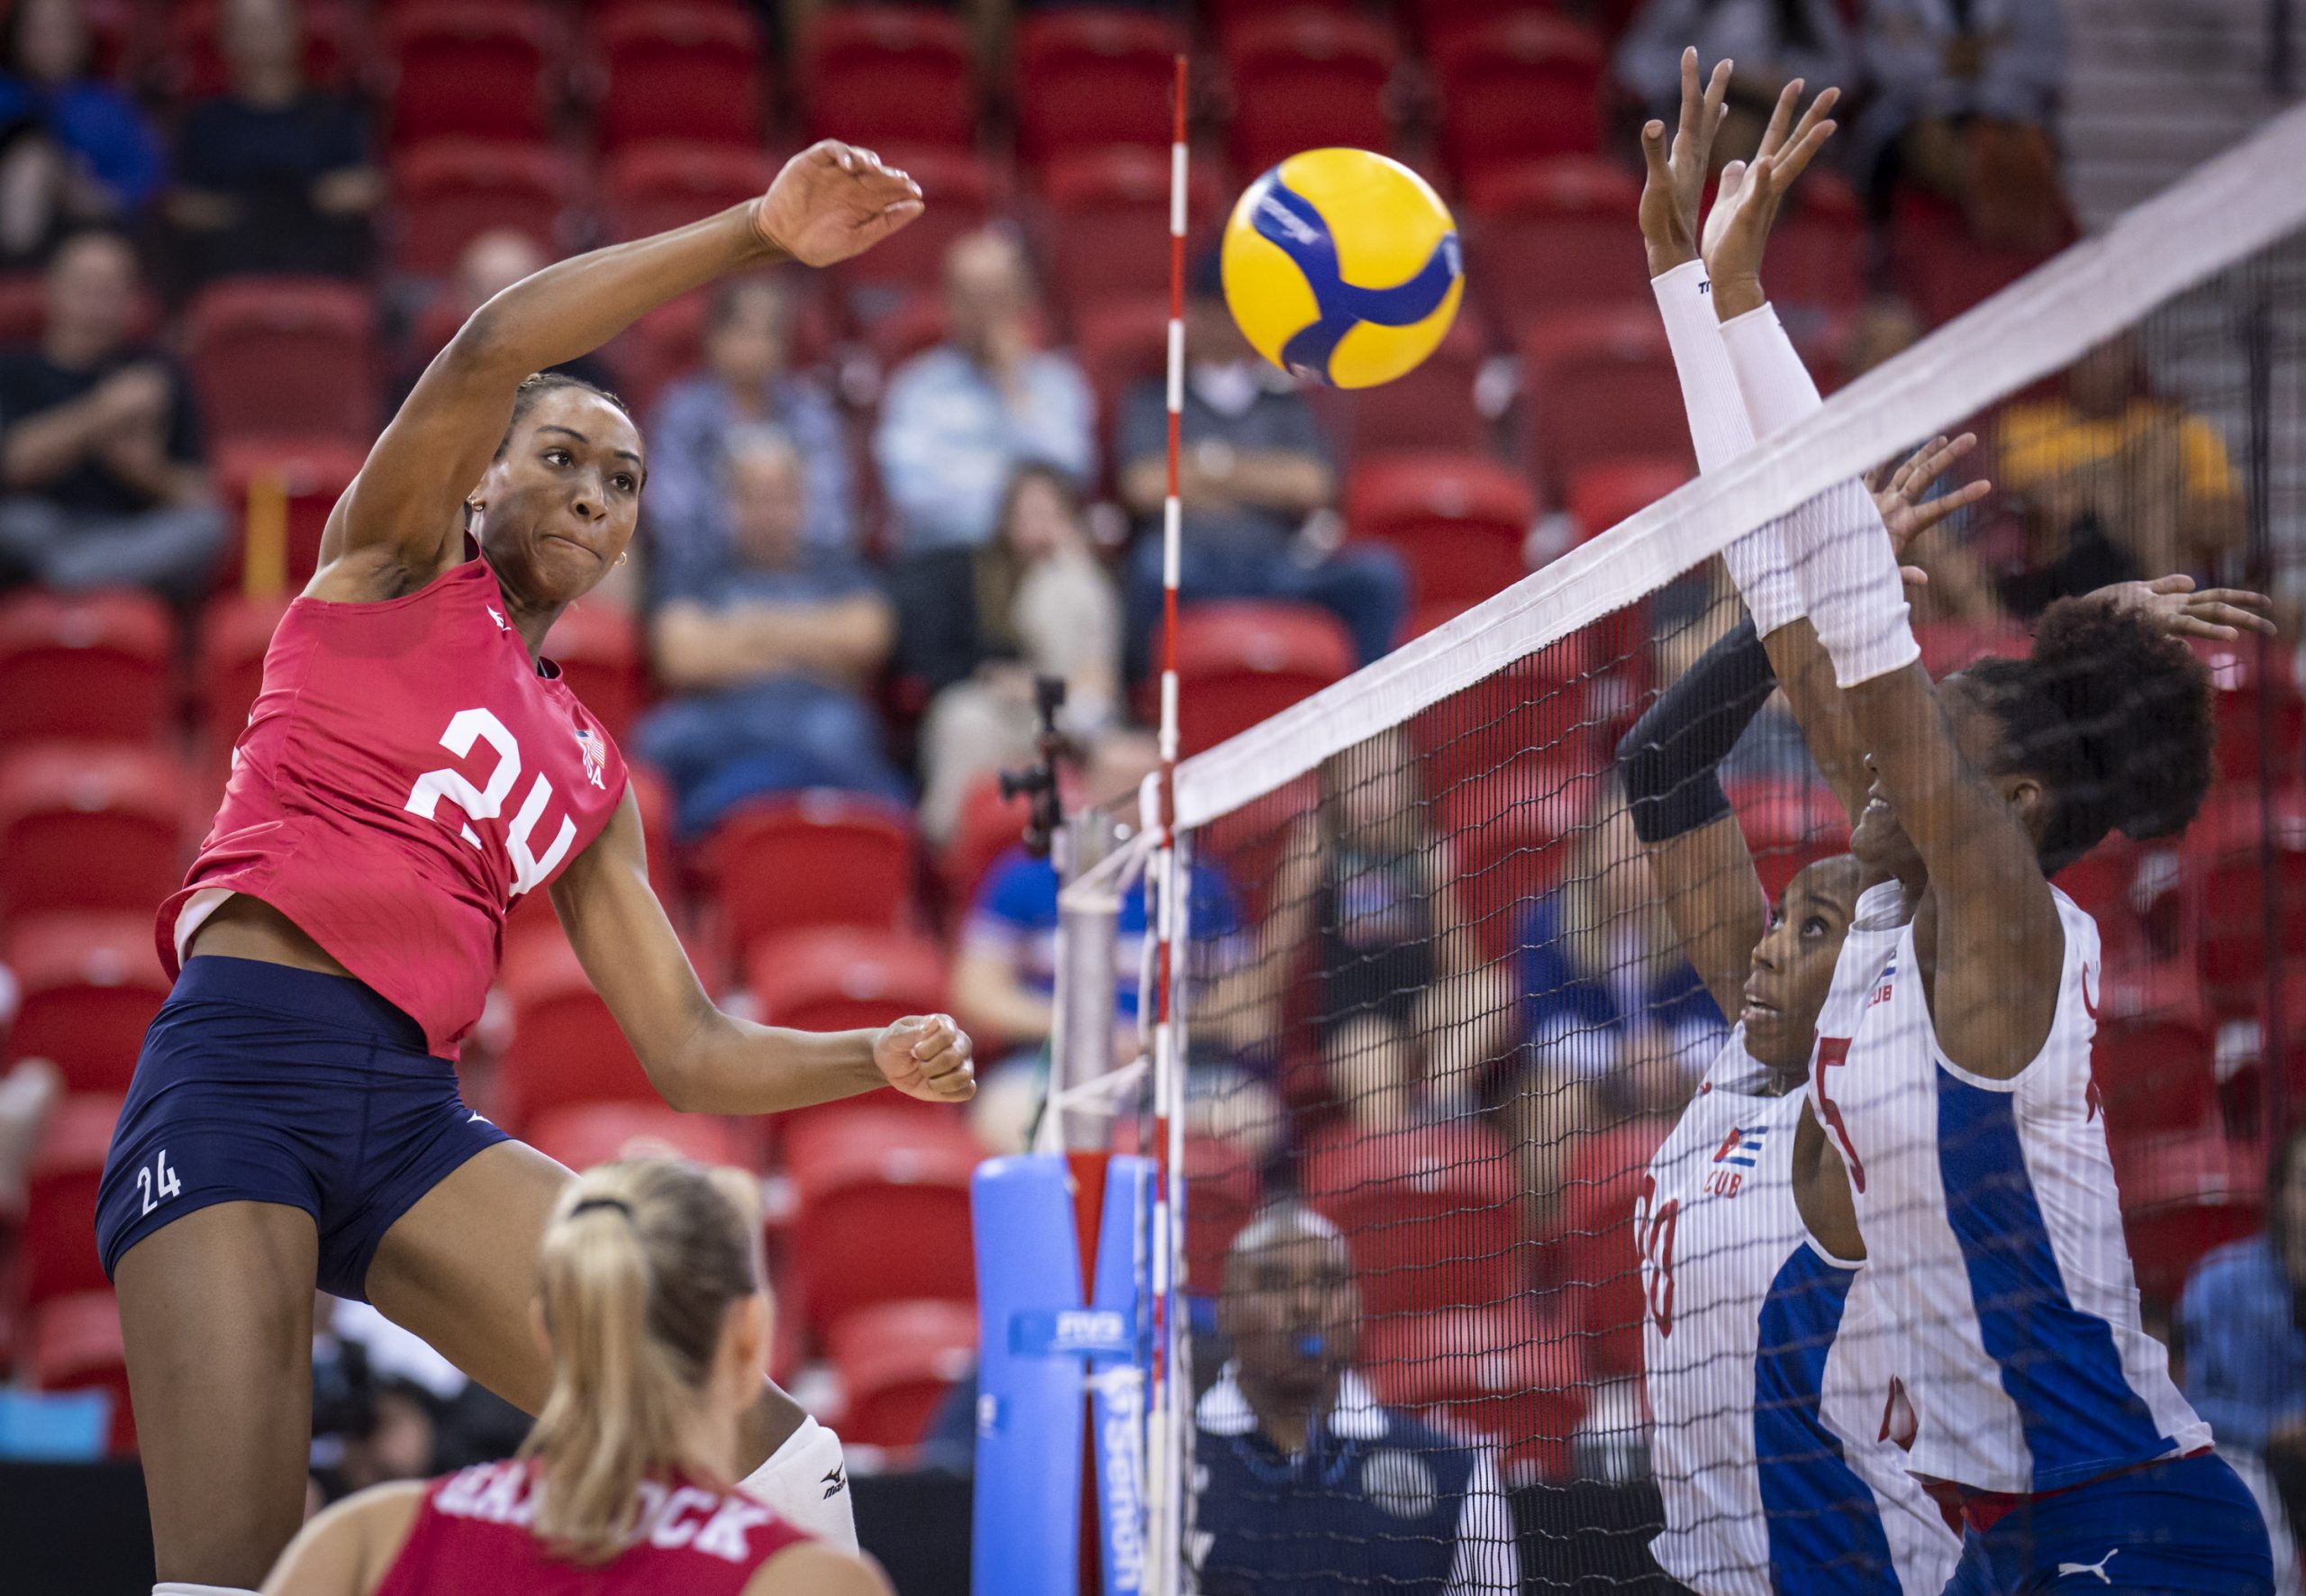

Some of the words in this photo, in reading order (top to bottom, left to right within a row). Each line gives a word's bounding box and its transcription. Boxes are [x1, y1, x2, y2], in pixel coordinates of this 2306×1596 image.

[404, 707, 577, 898] 24
[136, 1149, 182, 1217] 24
[1703, 1170, 1742, 1200] CUB
